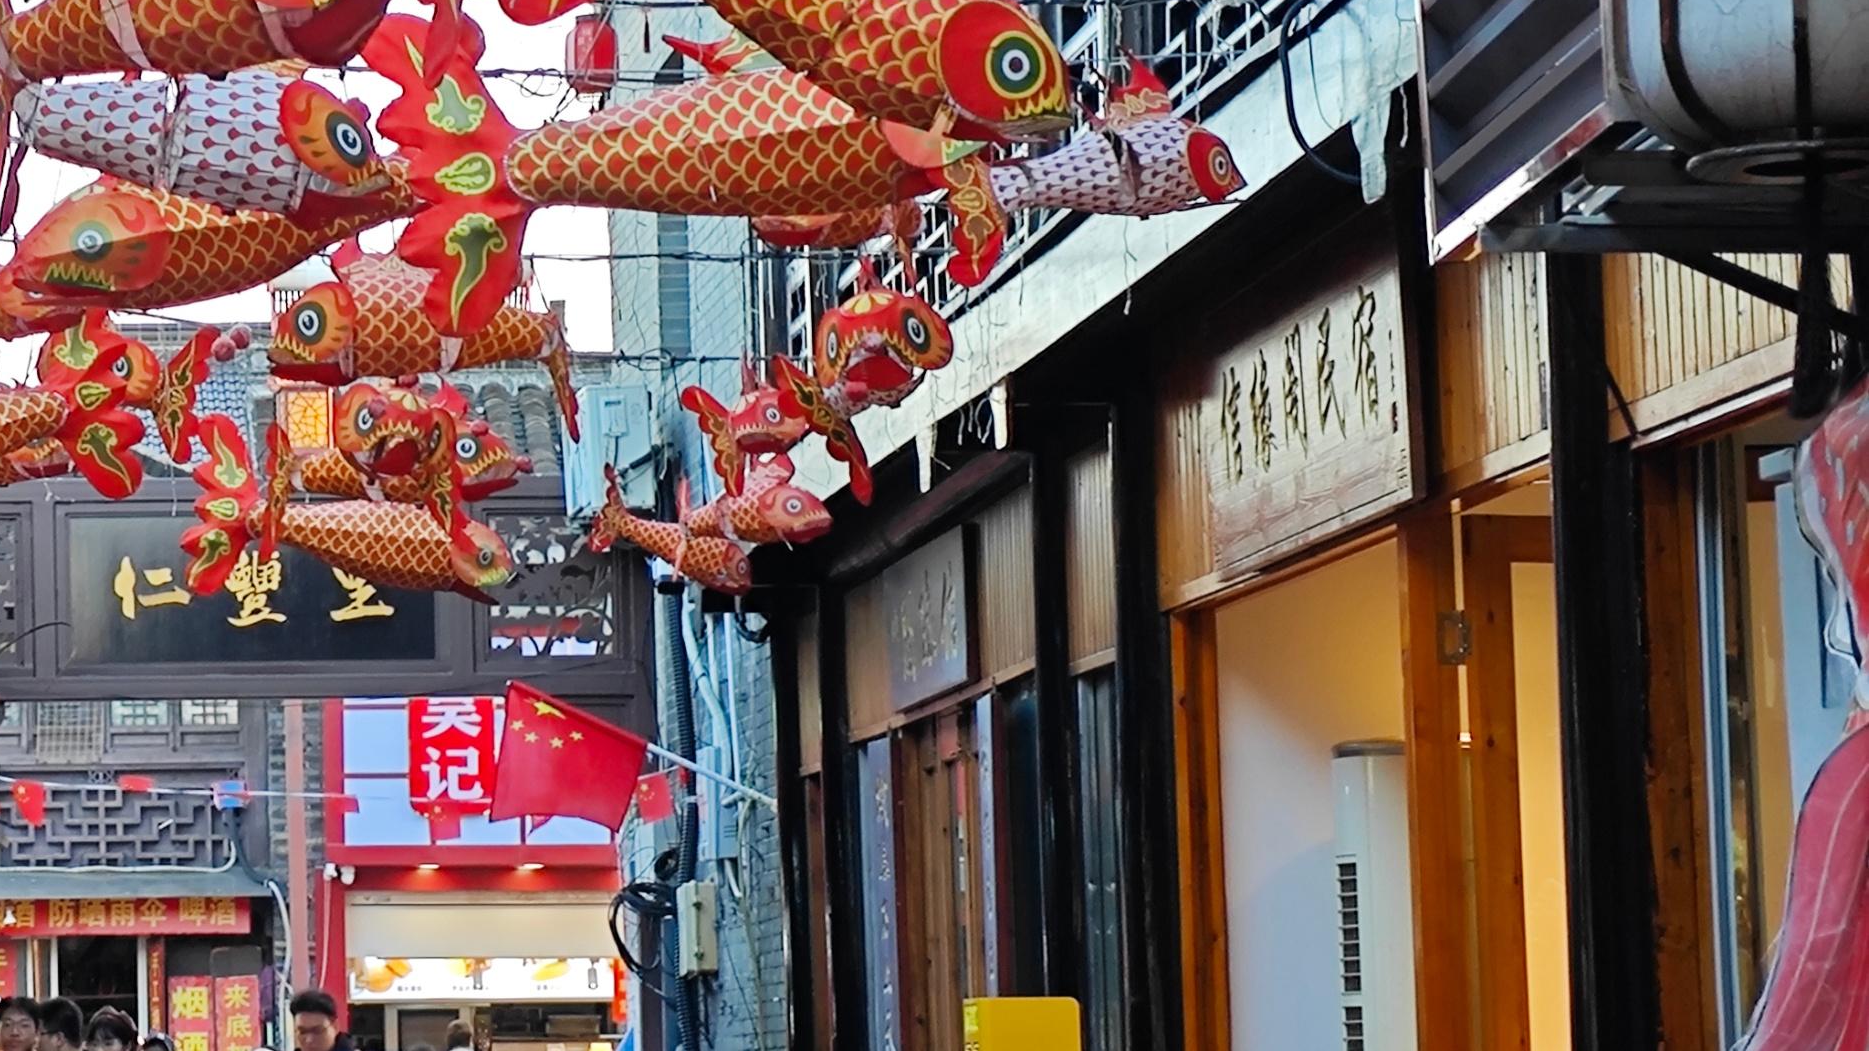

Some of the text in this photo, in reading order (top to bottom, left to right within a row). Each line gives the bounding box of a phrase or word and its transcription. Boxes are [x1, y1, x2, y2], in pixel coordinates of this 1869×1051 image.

[48, 898, 167, 928] 防晒雨伞
[179, 897, 237, 927] 啤酒
[224, 983, 253, 1051] 来底
